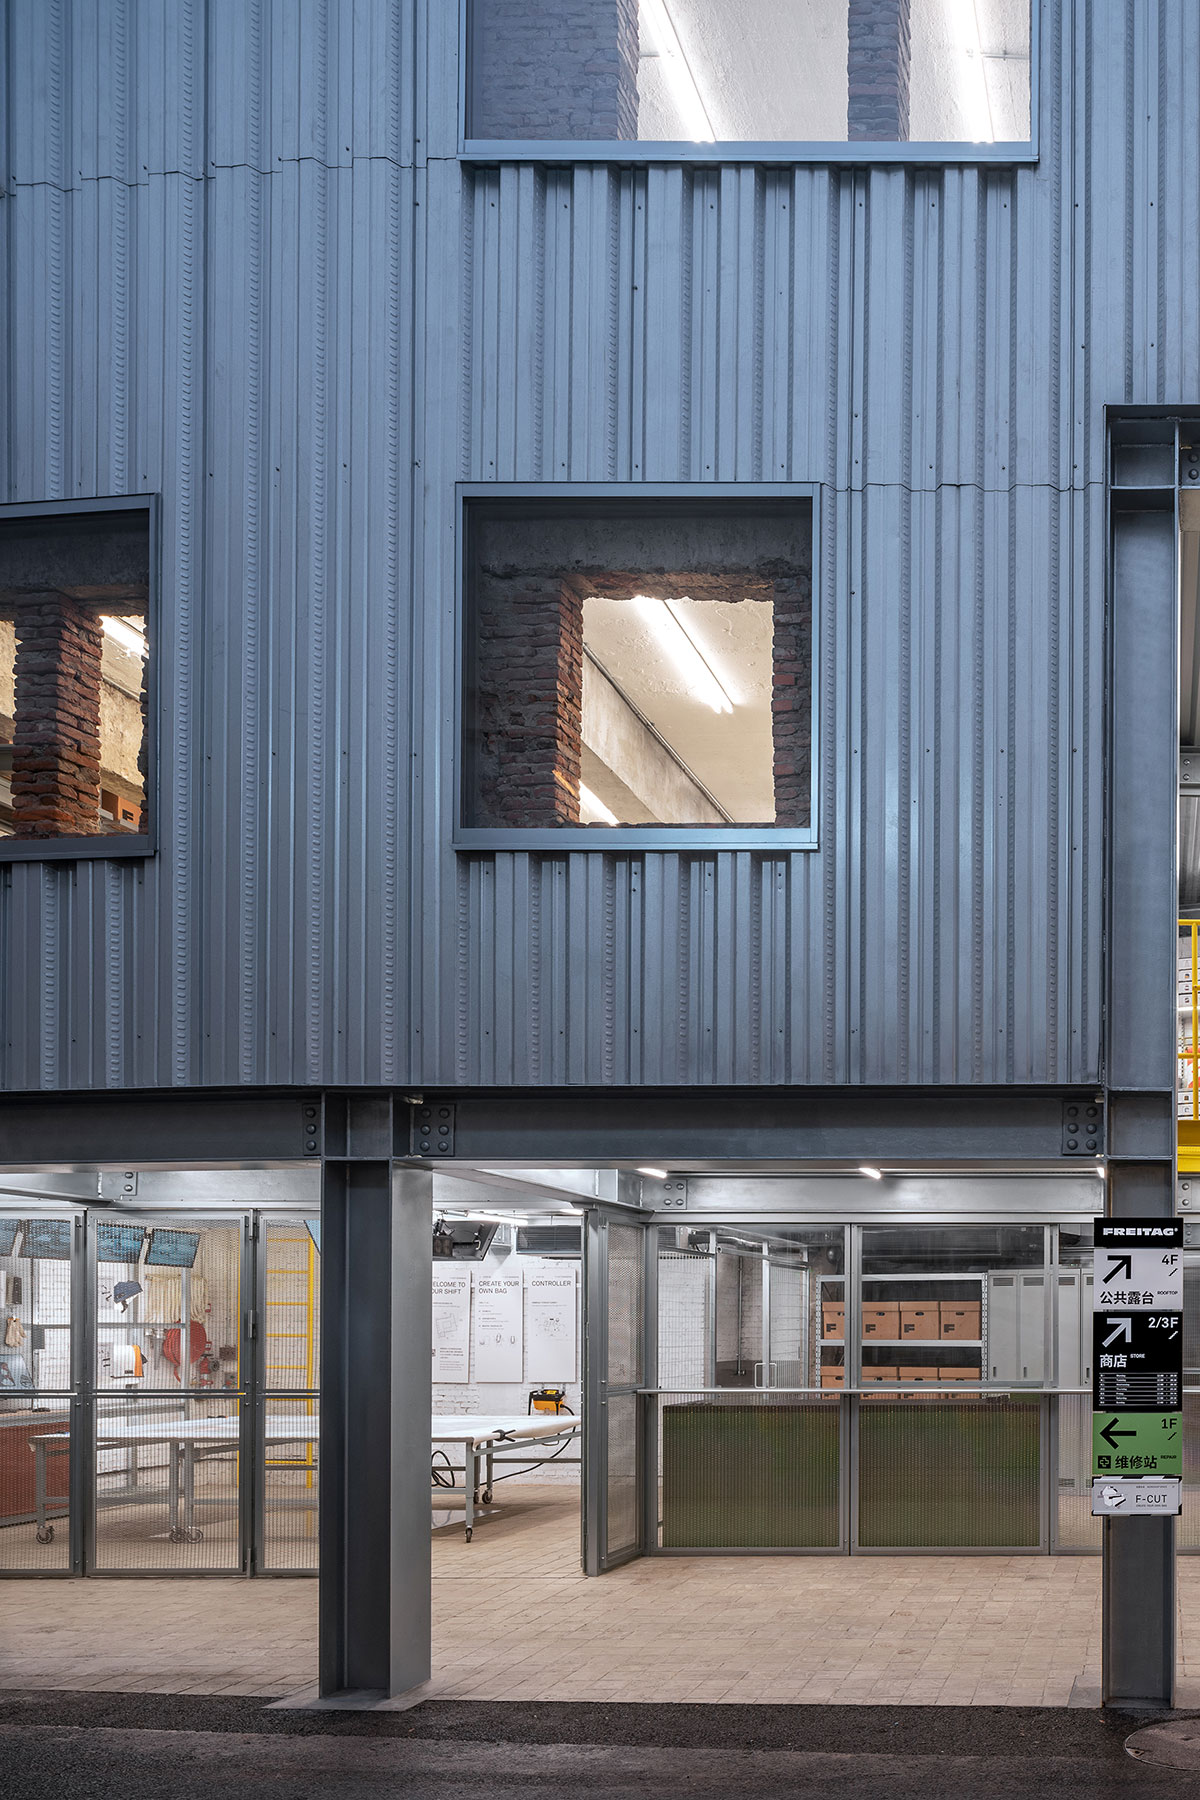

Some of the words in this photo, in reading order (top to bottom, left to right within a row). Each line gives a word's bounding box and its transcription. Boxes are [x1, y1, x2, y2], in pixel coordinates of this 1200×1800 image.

[122, 809, 134, 822] F
[1103, 1227, 1175, 1236] FREITAG
[1161, 1254, 1178, 1265] 4F
[1100, 1291, 1154, 1305] 公共露台
[826, 1323, 837, 1333] F
[1148, 1316, 1179, 1329] 2/3F
[865, 1324, 876, 1334] F
[904, 1324, 915, 1333] F
[943, 1324, 955, 1333] F
[1100, 1354, 1127, 1368] 商店
[1161, 1418, 1178, 1430] 1F
[1115, 1455, 1157, 1470] 维修站
[1135, 1494, 1168, 1504] F-CUT
